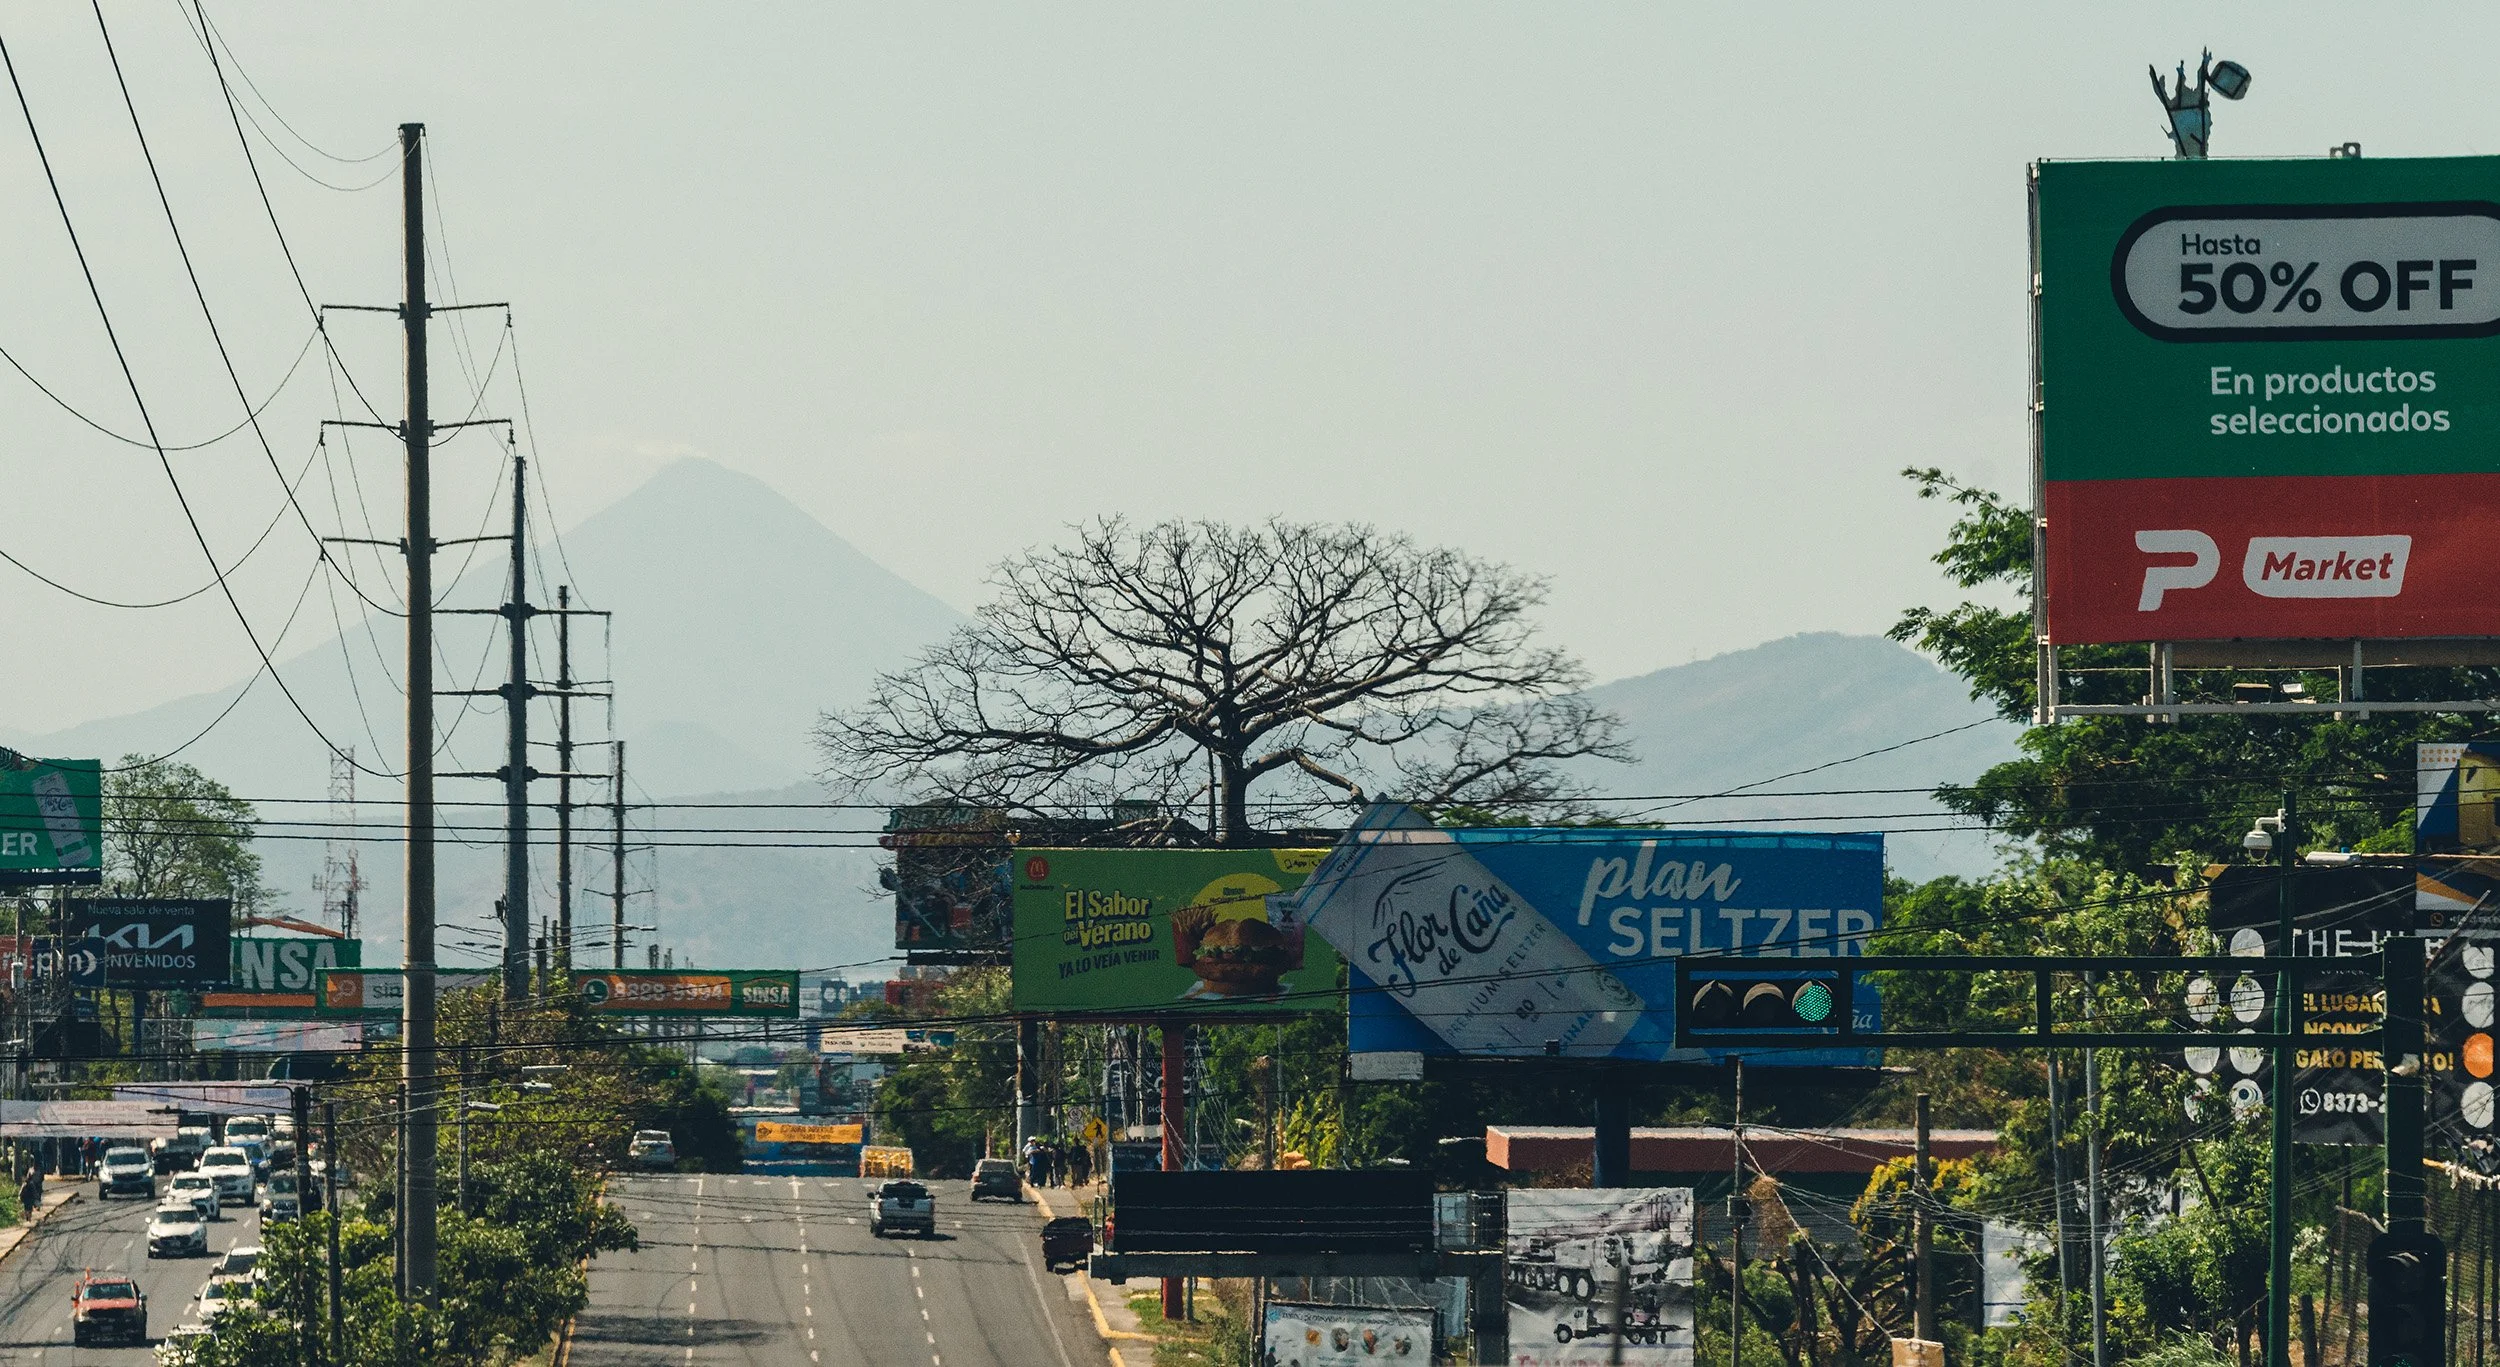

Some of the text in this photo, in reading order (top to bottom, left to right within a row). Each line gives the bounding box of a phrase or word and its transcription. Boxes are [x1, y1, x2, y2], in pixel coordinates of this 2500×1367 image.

[2181, 233, 2262, 256] Hasta
[2178, 259, 2477, 315] 50% OFF
[2210, 365, 2436, 401] En productos
[2210, 403, 2450, 436] seleccionados
[2260, 551, 2394, 581] Market
[1577, 840, 1741, 925] plan
[88, 904, 195, 916] Nueva sala de venta
[1064, 889, 1151, 921] El Sabor
[1078, 920, 1152, 947] Verano
[1368, 884, 1515, 998] Flor de Caña
[1607, 906, 1876, 957] SELTZER
[107, 954, 196, 969] NVENIDOS
[241, 941, 337, 990] NSA
[1058, 949, 1160, 979] YA LO VEÍA VENIR
[742, 986, 790, 1003] SINSA
[1446, 923, 1547, 1039] PREMIUM SELTZER
[2295, 1049, 2346, 1069] GALO
